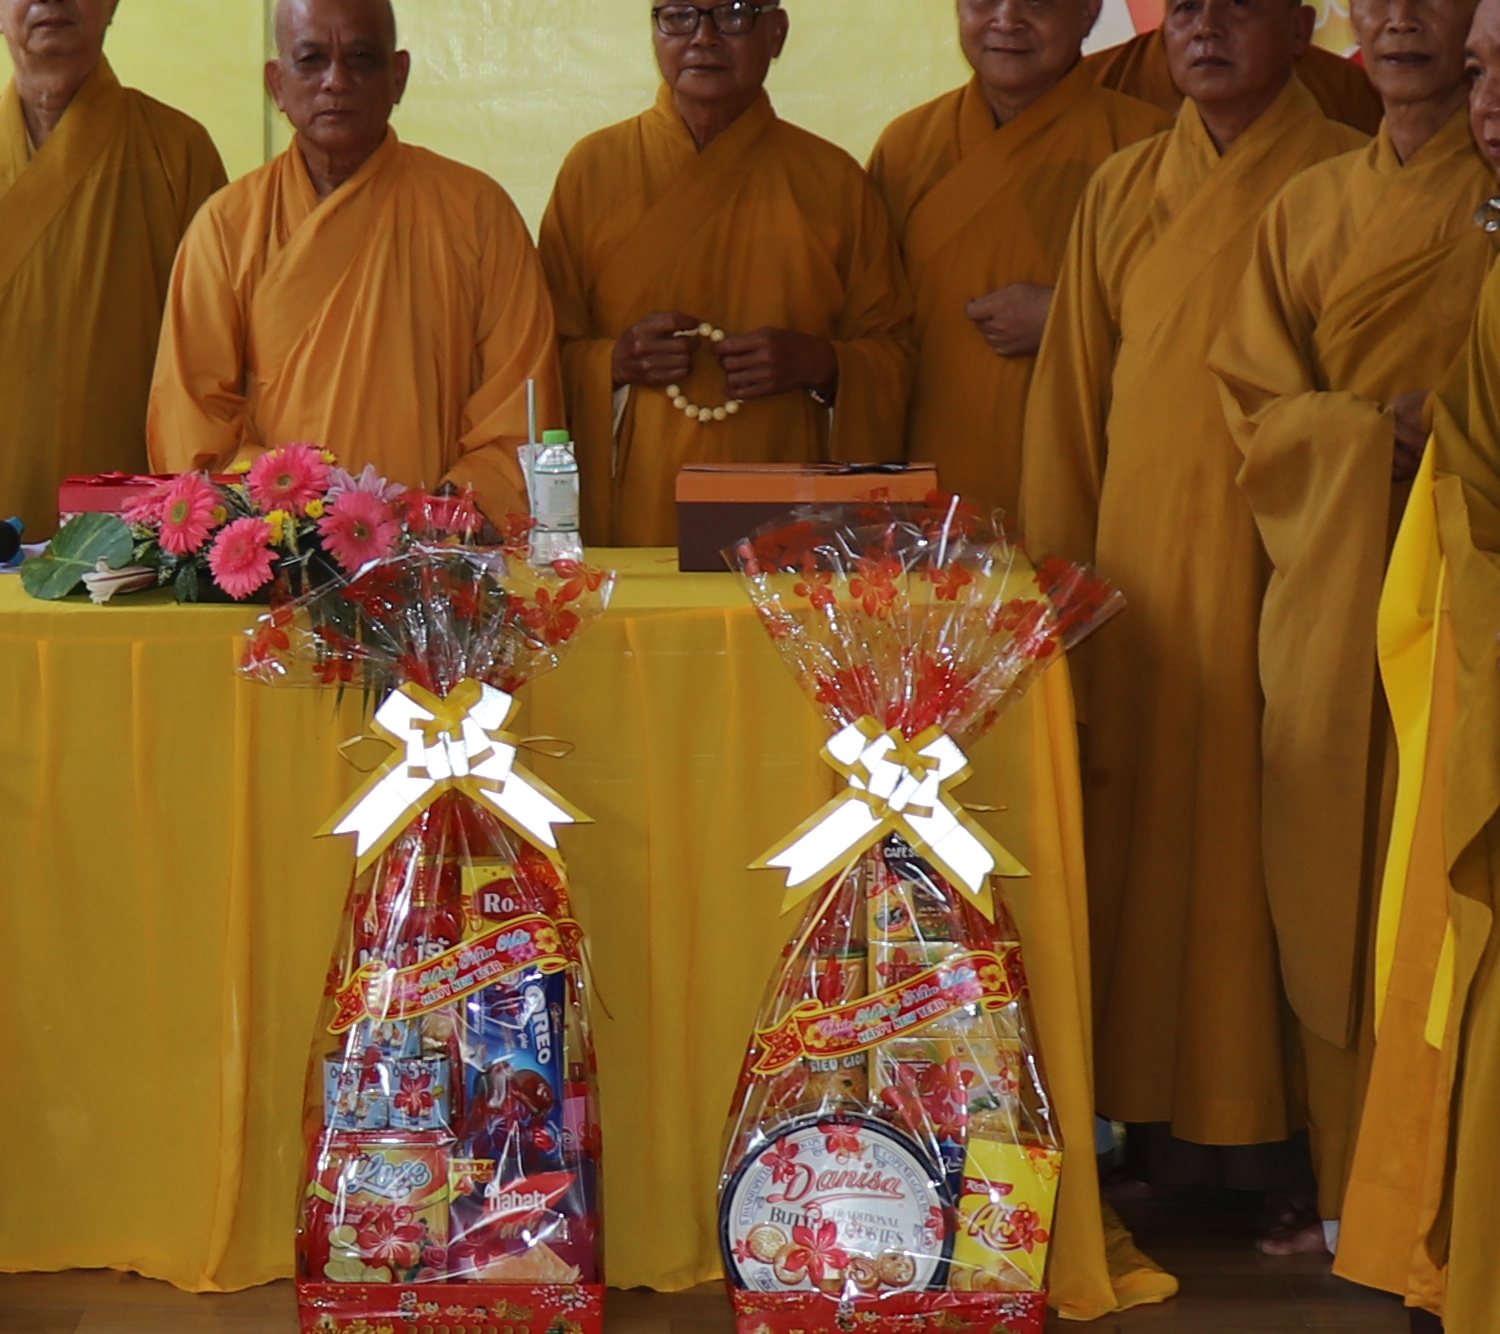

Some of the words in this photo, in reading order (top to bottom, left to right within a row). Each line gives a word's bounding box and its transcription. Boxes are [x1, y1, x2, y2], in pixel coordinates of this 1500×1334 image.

[421, 987, 451, 1007] HAPPY
[451, 974, 474, 992] NEW
[474, 960, 505, 980] YEAR
[523, 984, 551, 1065] OREO
[858, 1022, 892, 1043] HAPPY
[893, 1013, 917, 1030] NEW
[917, 998, 947, 1018] YEAR
[766, 1163, 906, 1203] Danisa
